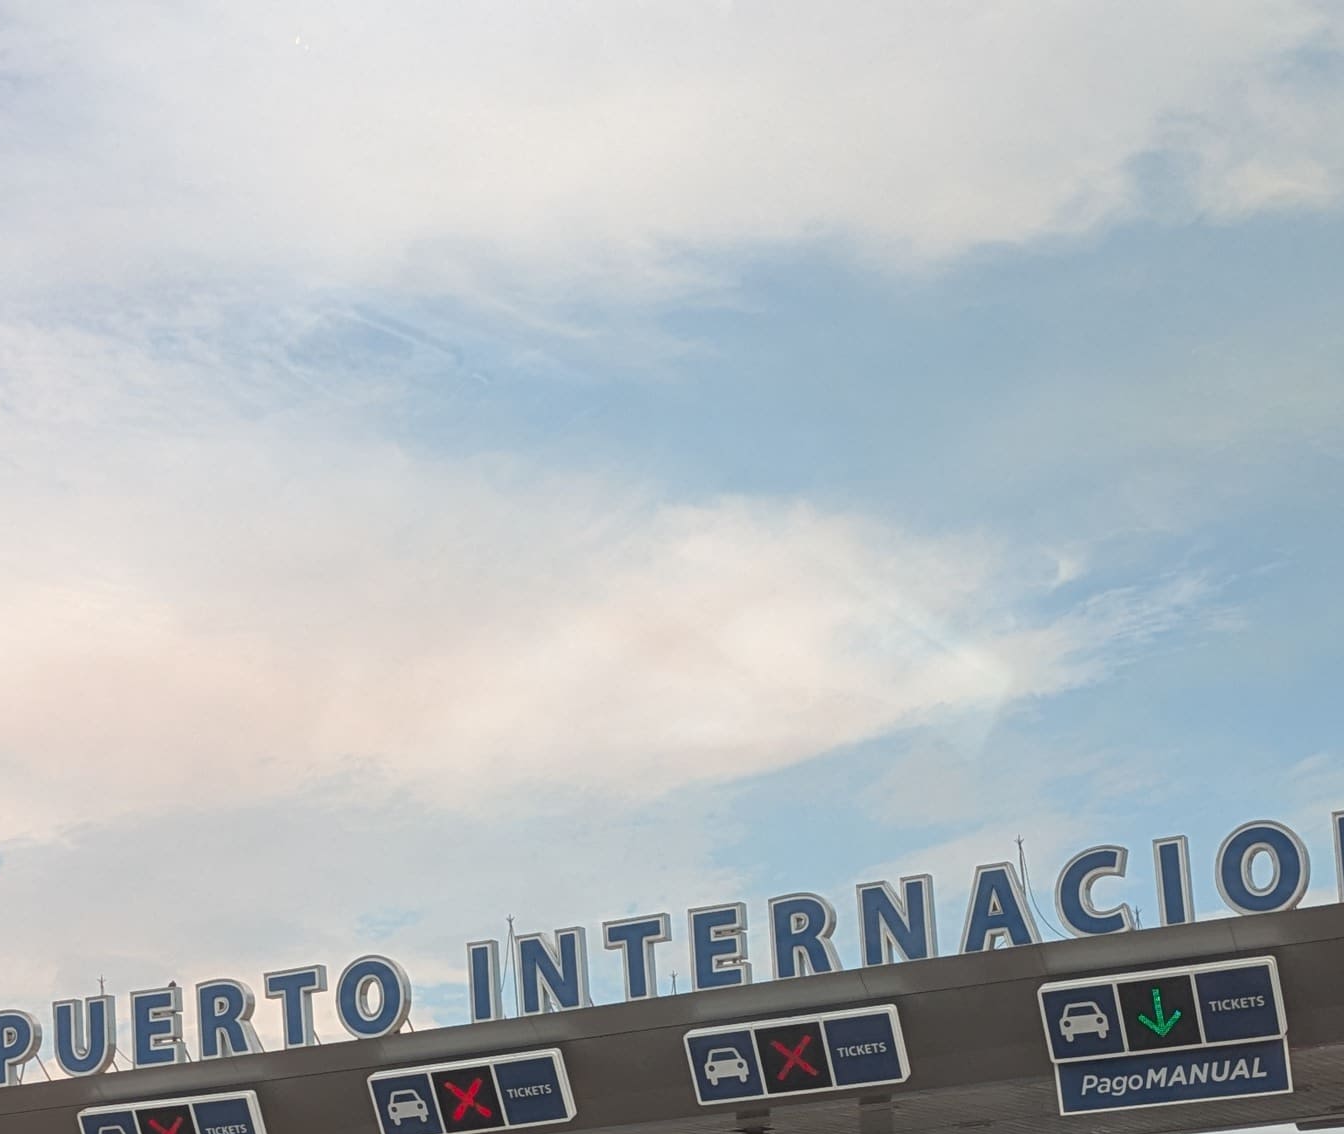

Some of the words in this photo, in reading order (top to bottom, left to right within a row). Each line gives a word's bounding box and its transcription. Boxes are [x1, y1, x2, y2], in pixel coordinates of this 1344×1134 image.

[1208, 995, 1265, 1012] TICKETS
[837, 1041, 887, 1058] TICKETS
[507, 1083, 552, 1100] TICKETS
